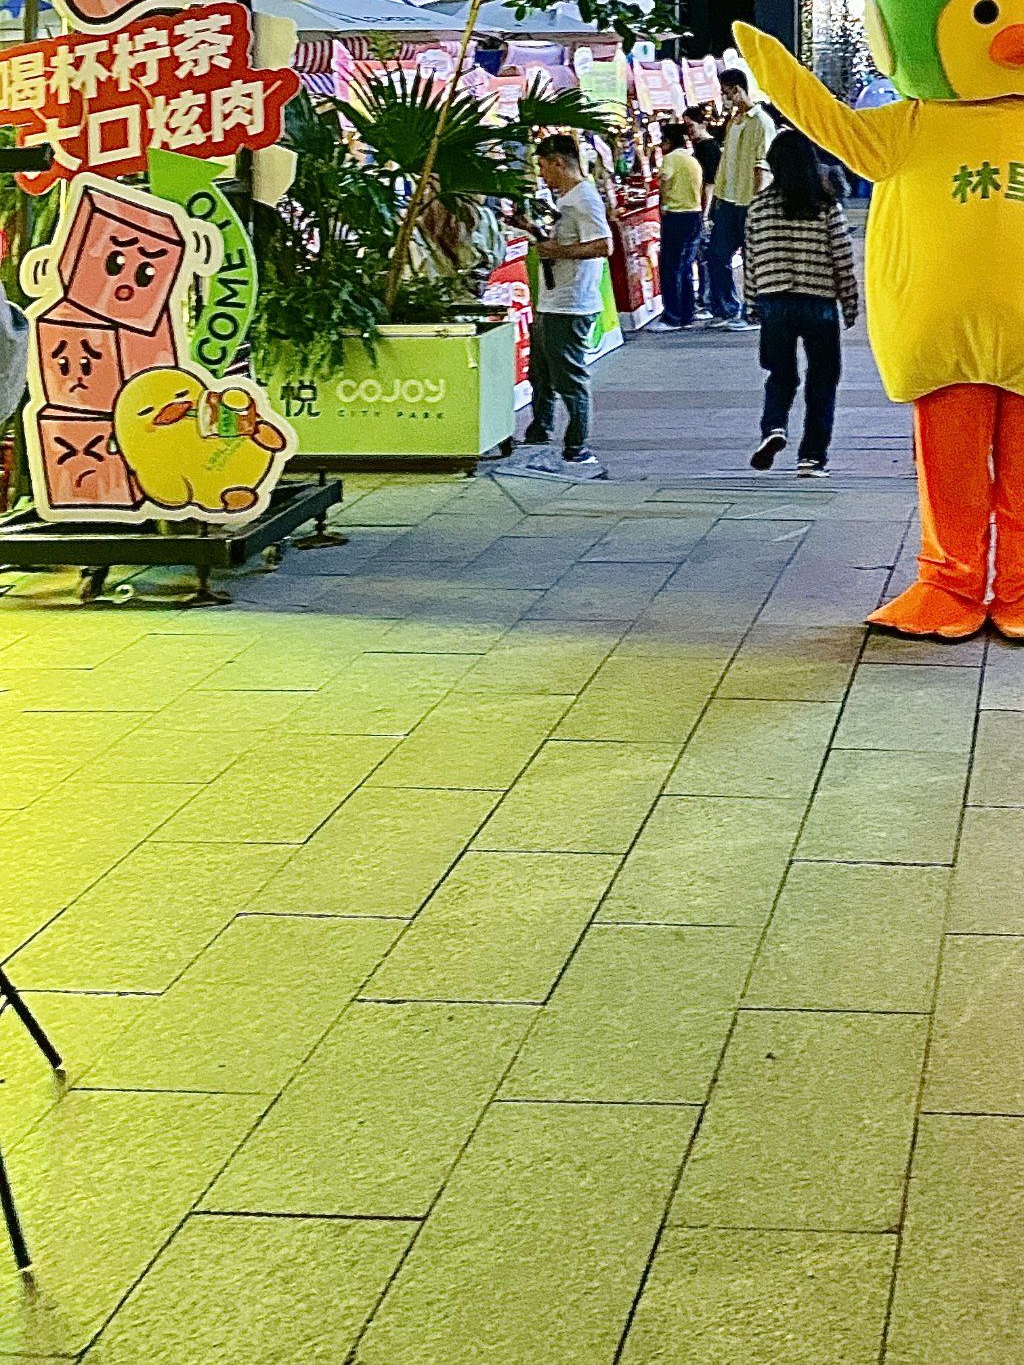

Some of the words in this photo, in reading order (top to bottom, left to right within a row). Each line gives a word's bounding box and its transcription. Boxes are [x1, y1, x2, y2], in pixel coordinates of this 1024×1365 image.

[0, 14, 234, 112] 喝杯柠茶
[24, 79, 265, 172] 大口炫肉
[336, 378, 447, 403] COJOY
